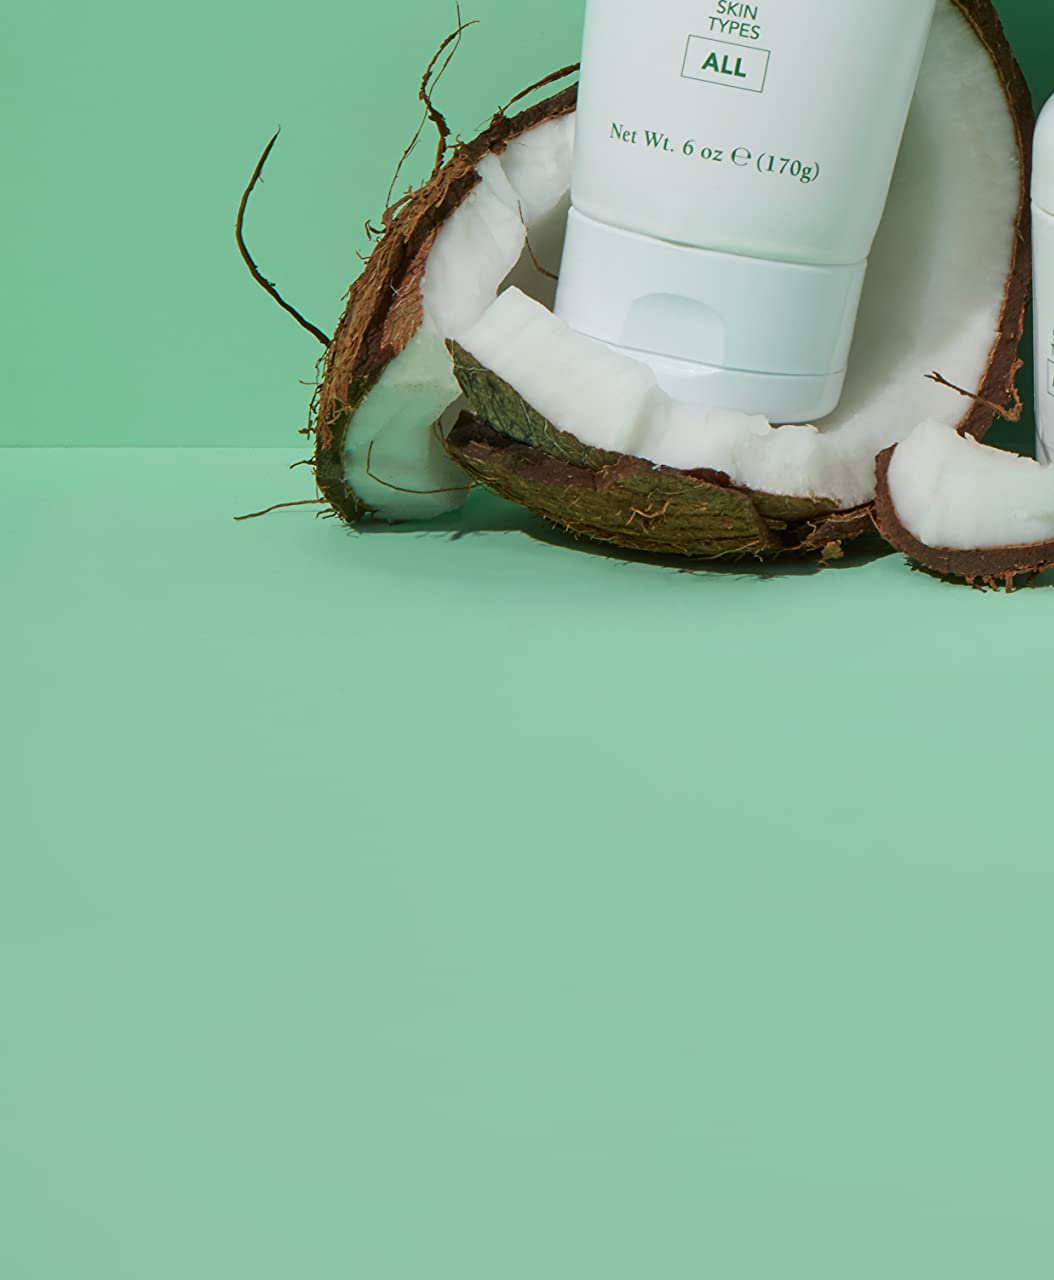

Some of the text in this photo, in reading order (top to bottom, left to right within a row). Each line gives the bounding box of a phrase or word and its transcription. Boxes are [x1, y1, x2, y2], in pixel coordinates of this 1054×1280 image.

[717, 0, 758, 20] SKIN
[709, 16, 760, 40] TYPES
[701, 52, 746, 78] ALL
[610, 123, 637, 144] Net
[645, 130, 674, 152] Wt.
[683, 139, 694, 155] 6
[701, 148, 723, 161] oz
[757, 153, 819, 183] (170g)
